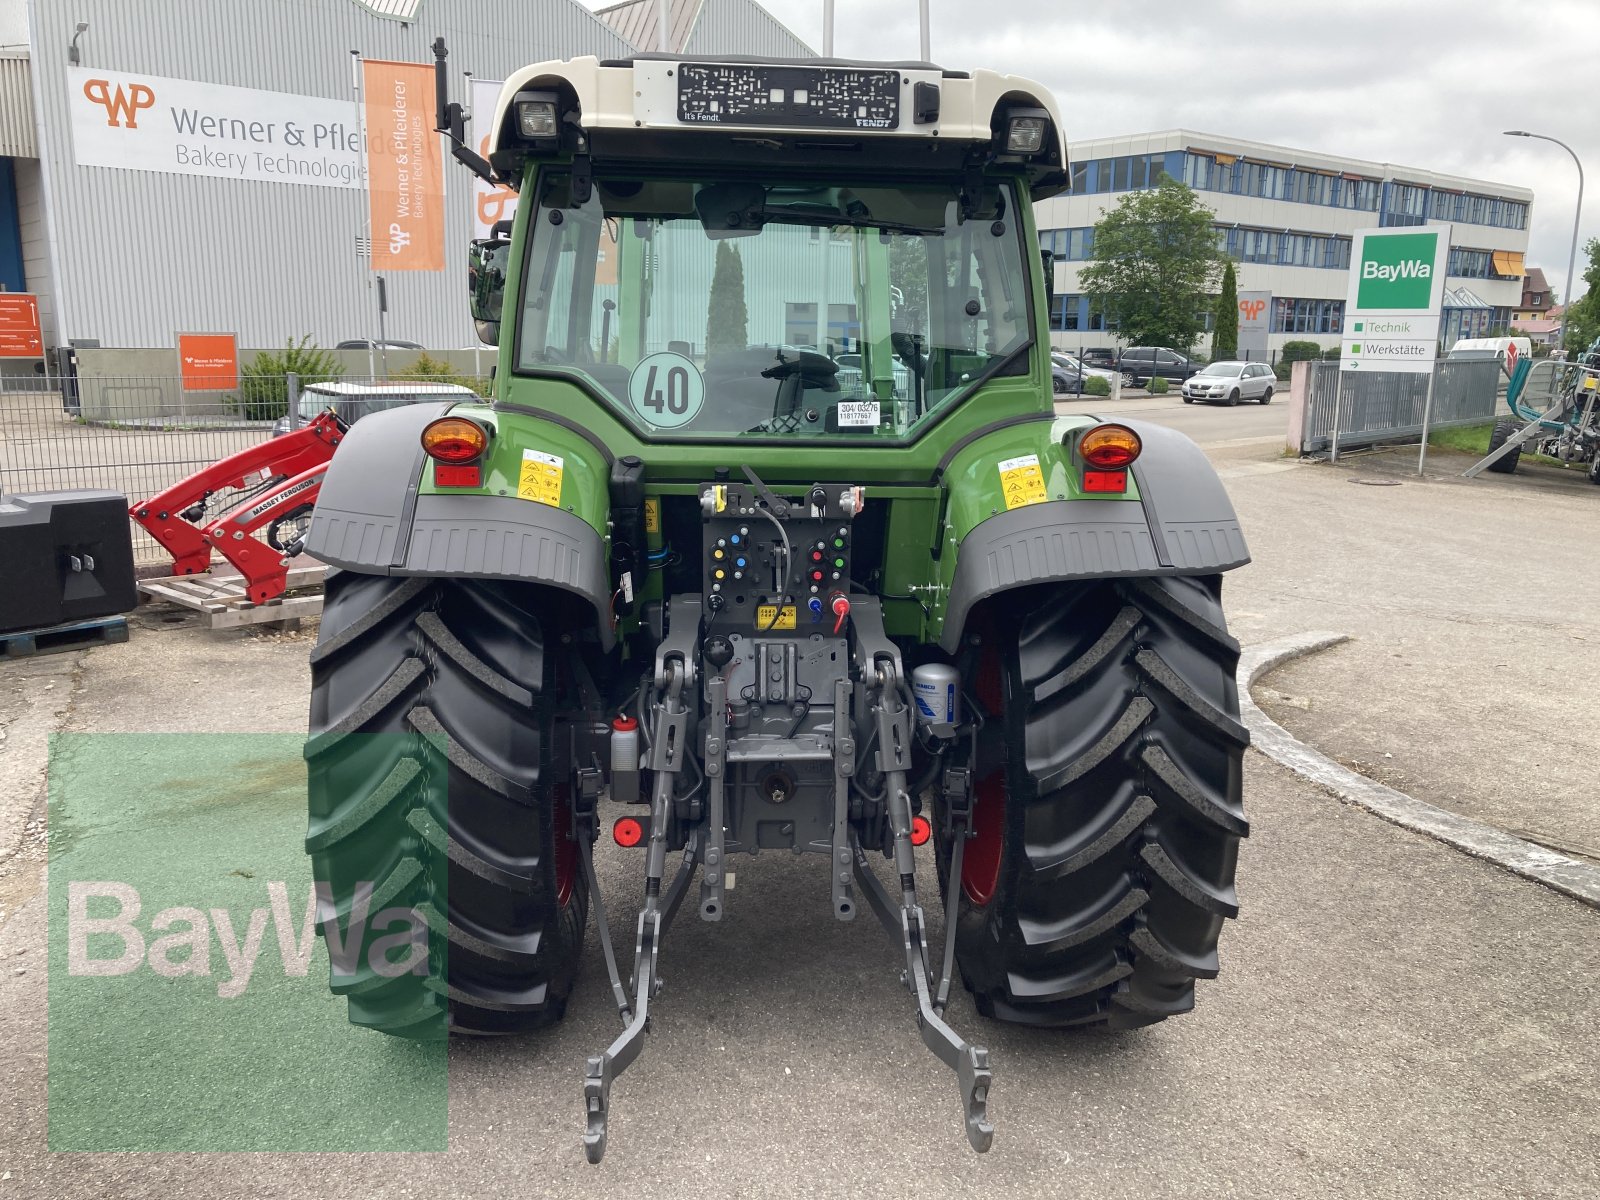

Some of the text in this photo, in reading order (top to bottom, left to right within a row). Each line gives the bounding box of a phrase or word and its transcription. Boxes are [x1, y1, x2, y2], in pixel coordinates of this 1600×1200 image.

[170, 106, 276, 143] Werner
[283, 121, 306, 147] &
[391, 79, 408, 149] Pfleiderer
[684, 112, 721, 122] It's Fendt.
[855, 118, 892, 128] FENDT
[175, 144, 247, 175] Bakery
[395, 153, 409, 165] &
[410, 115, 425, 218] Bakery Technologies
[396, 167, 410, 218] Werner
[1363, 260, 1431, 283] BayWa
[1368, 321, 1411, 333] Technik
[1366, 343, 1425, 355] Werkstätte
[643, 365, 689, 415] 40
[252, 478, 315, 516] MASSEY FERGUSON
